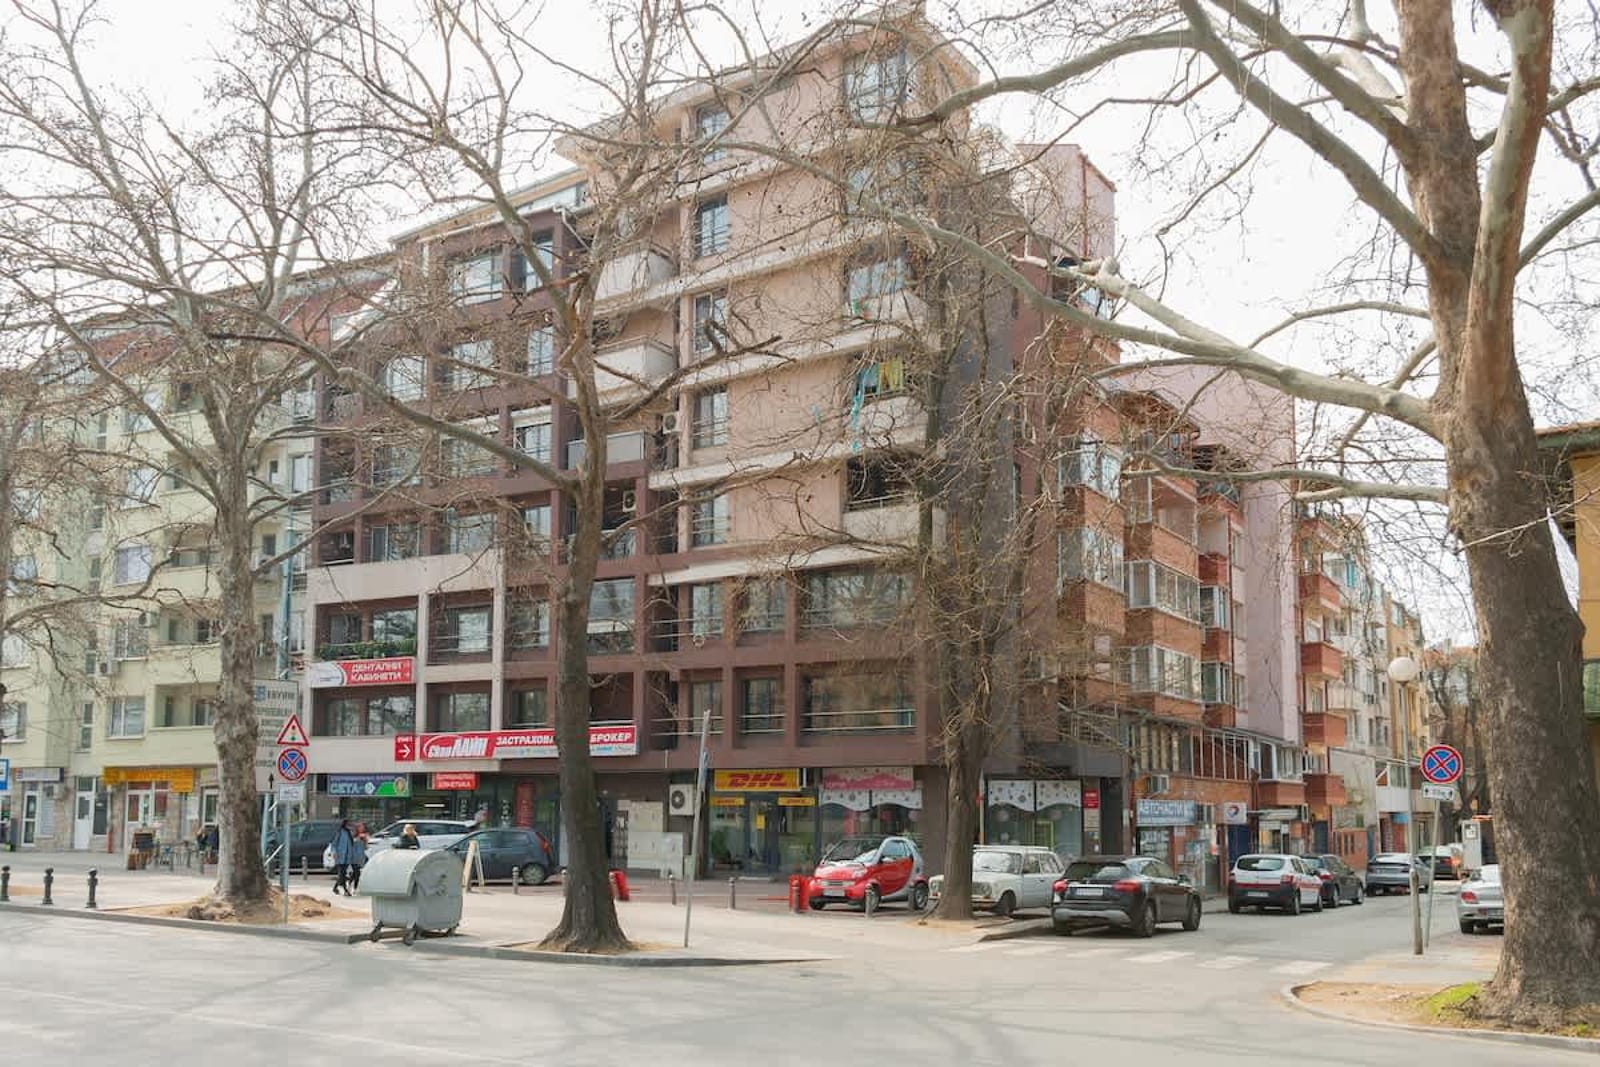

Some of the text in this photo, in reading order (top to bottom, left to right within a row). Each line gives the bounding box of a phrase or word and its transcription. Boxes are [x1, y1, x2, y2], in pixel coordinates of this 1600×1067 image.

[352, 662, 401, 672] ДЕНТАЛНИ
[495, 732, 632, 746] ЗАСТРАХОВ БРОКЕР
[729, 773, 787, 788] DHL
